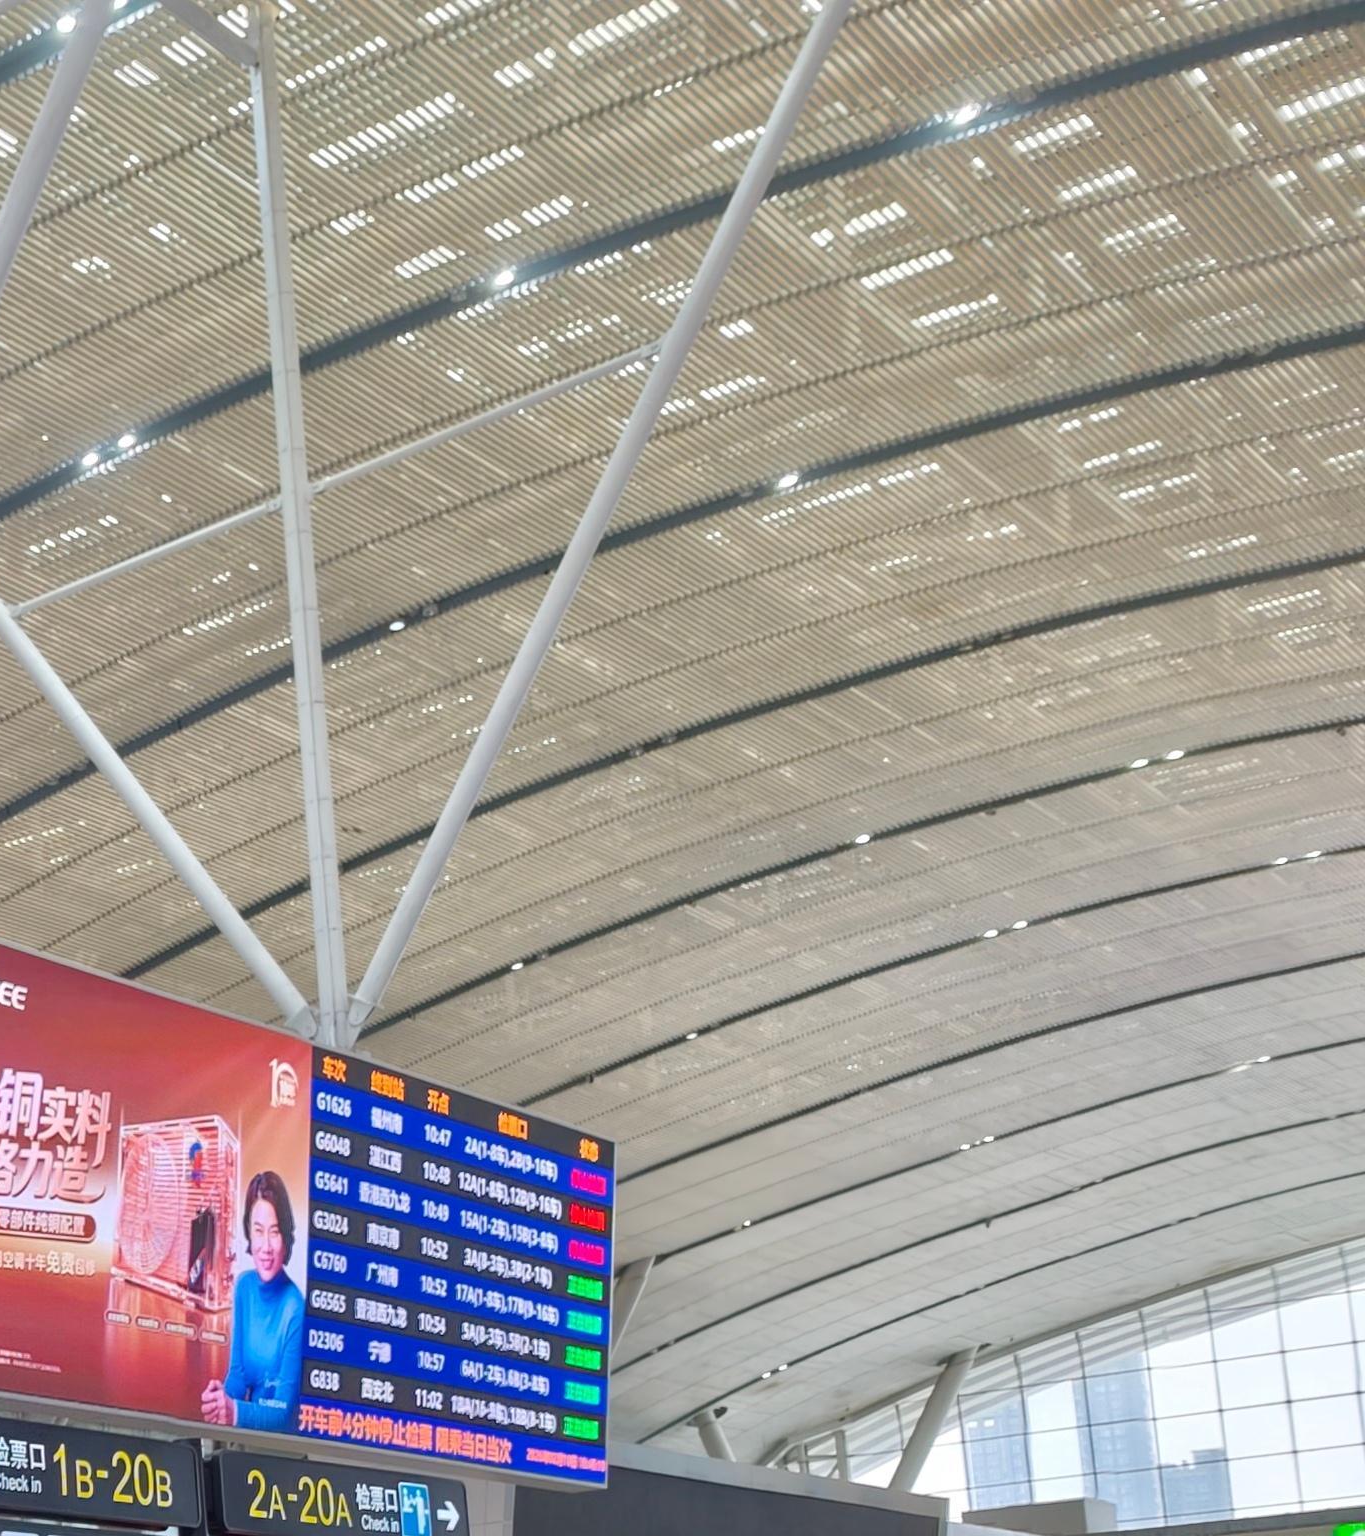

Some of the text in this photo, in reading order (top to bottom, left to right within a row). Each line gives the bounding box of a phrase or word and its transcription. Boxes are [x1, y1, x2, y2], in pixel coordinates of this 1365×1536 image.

[322, 1056, 347, 1083] 车次
[428, 1089, 450, 1116] 开点
[316, 1092, 352, 1118] G1626
[424, 1124, 452, 1148] 10:47
[423, 1161, 451, 1186] 10:48
[421, 1200, 450, 1223] 10:49
[312, 1209, 350, 1236] G3024
[421, 1237, 449, 1261] 10:52
[420, 1275, 447, 1298] 10:52
[418, 1312, 446, 1335] 10:54
[309, 1329, 344, 1353] D2306
[417, 1351, 445, 1374] 10:57
[415, 1389, 443, 1411] 11:02
[31, 1475, 42, 1494] in
[53, 1443, 173, 1508] 1B-20B
[247, 1469, 398, 1528] 2A-20A 检票口
[361, 1515, 400, 1534] Check in
